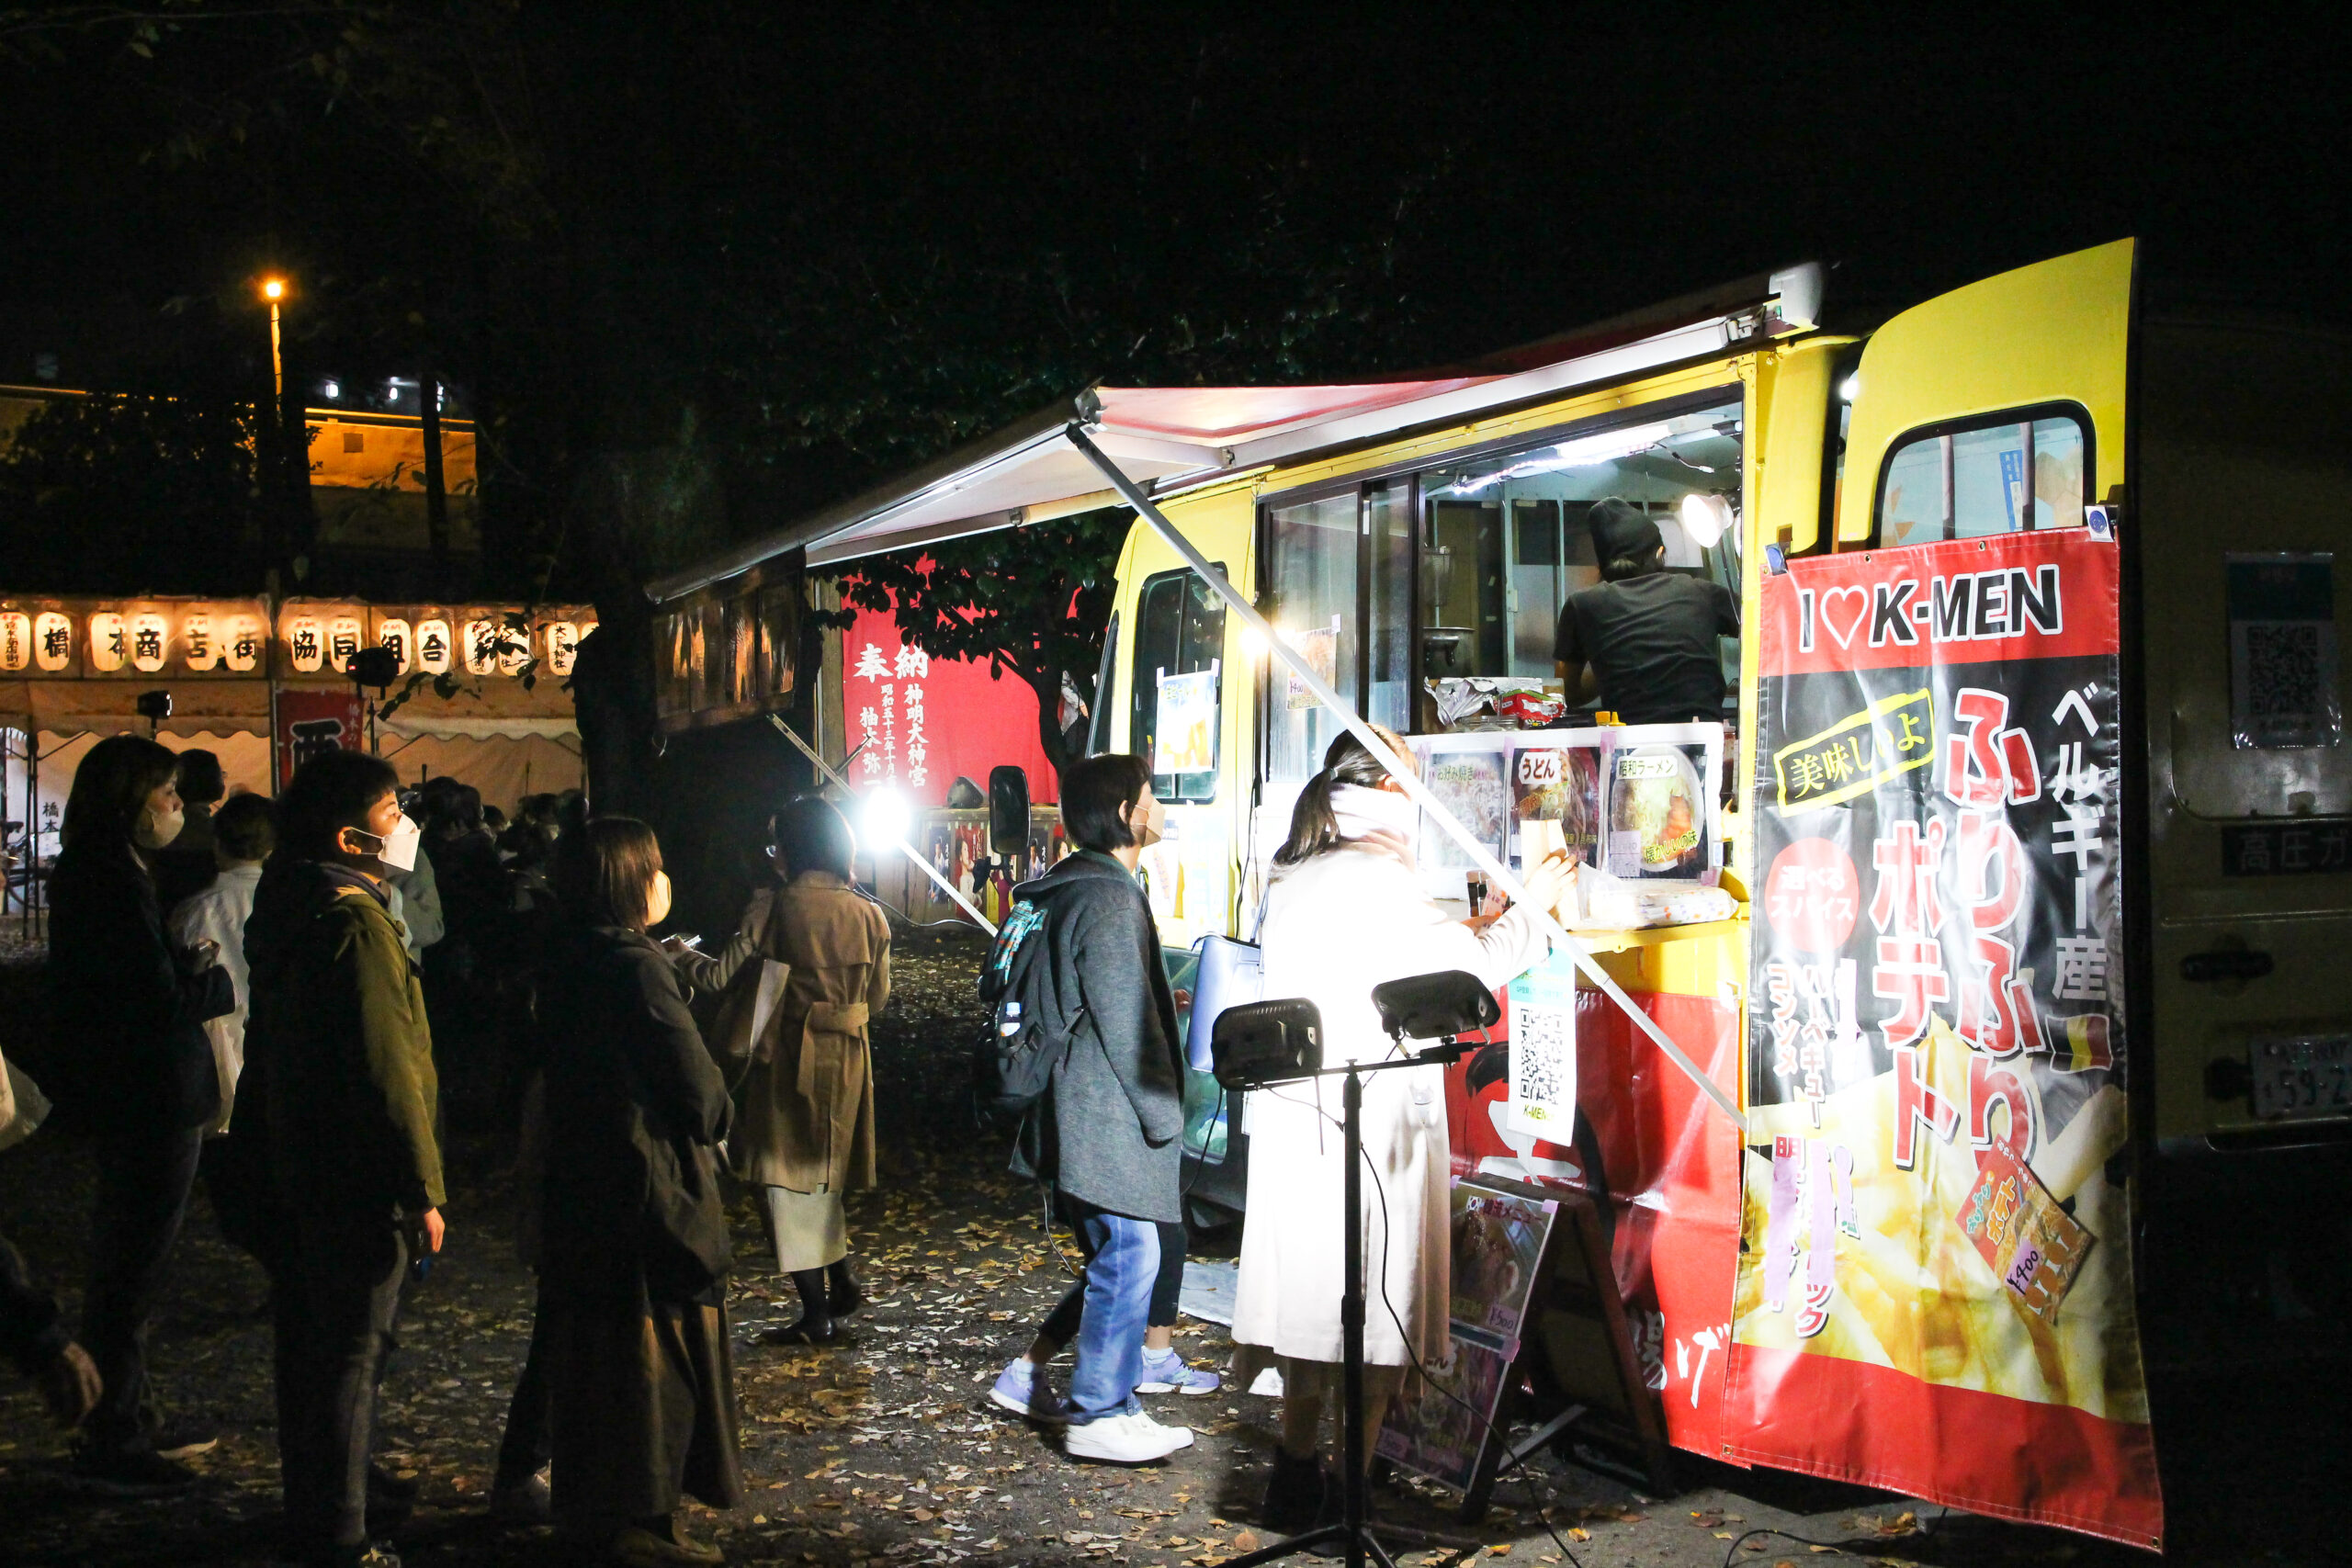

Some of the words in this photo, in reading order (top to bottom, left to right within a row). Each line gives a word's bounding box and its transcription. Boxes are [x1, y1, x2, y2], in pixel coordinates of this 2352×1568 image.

[1868, 564, 2064, 649] K-MEN
[853, 643, 929, 683] 奉納
[903, 682, 930, 788] 神明大神宮
[1521, 758, 1555, 780] うどん
[1619, 760, 1675, 777] 昭和ラーメン
[1790, 712, 1928, 800] 美味しいよ
[2051, 682, 2108, 1000] ベルギー産
[1767, 964, 1801, 1077] コンソメ
[1868, 820, 1959, 1169] ポテト
[2007, 1249, 2040, 1295] ¥400
